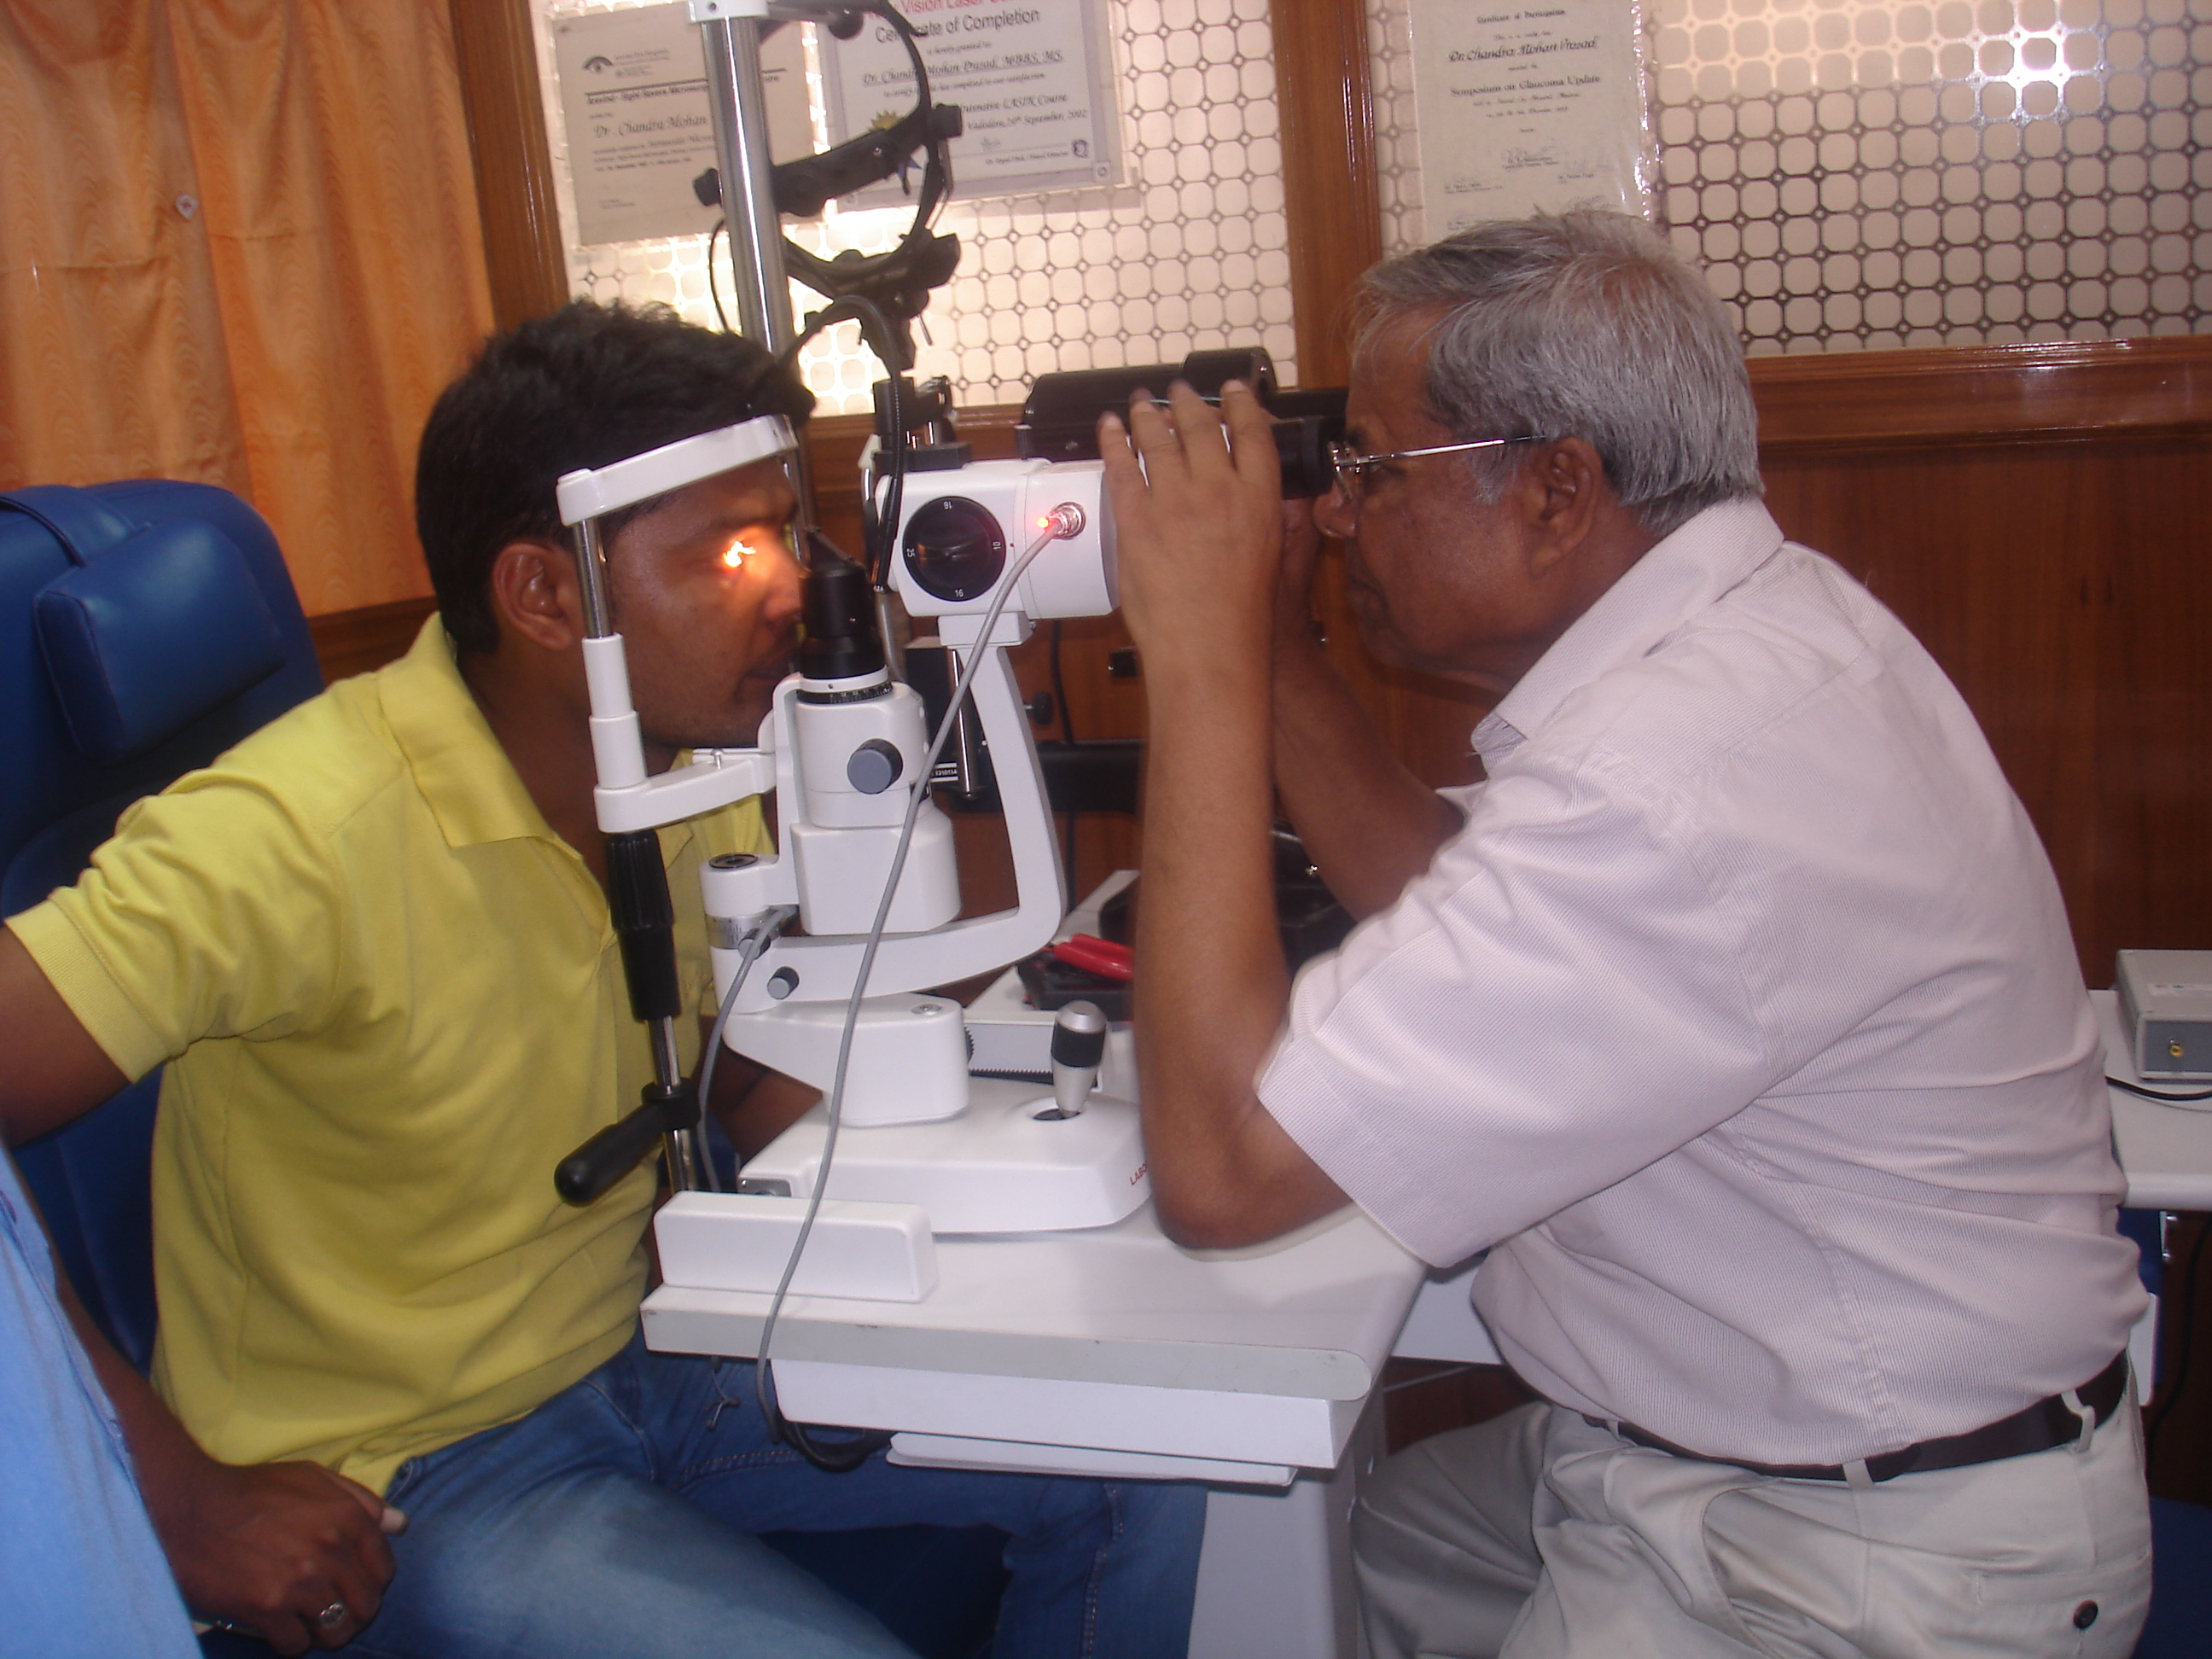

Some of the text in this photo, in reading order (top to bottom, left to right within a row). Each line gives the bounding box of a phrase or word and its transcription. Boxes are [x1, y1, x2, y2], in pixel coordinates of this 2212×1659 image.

[876, 8, 1040, 44] Cecate of Completion
[882, 67, 918, 83] Chandr
[1451, 84, 1501, 96] Symposium
[1519, 79, 1564, 90] Glaucoma
[1567, 74, 1601, 85] Update
[944, 501, 952, 509] 16
[992, 541, 1001, 550] 10
[906, 548, 915, 557] 25
[955, 589, 963, 597] 16
[1129, 1160, 1147, 1186] LABO
